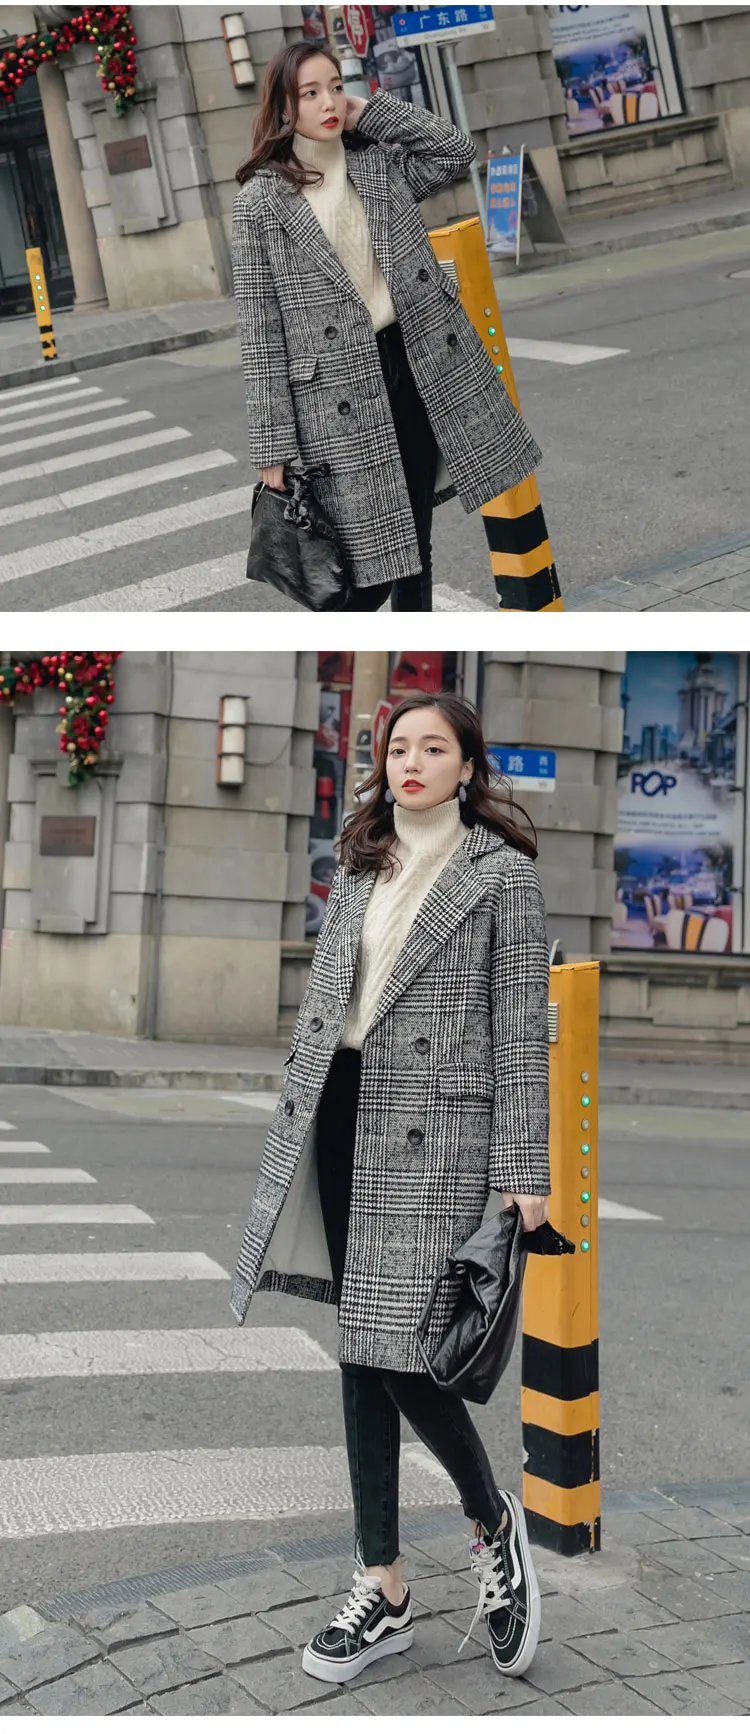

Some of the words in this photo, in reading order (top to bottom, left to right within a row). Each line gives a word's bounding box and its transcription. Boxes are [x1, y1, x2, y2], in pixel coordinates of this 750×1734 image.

[347, 5, 364, 46] 停
[419, 8, 468, 29] 广东路
[631, 770, 677, 797] POP
